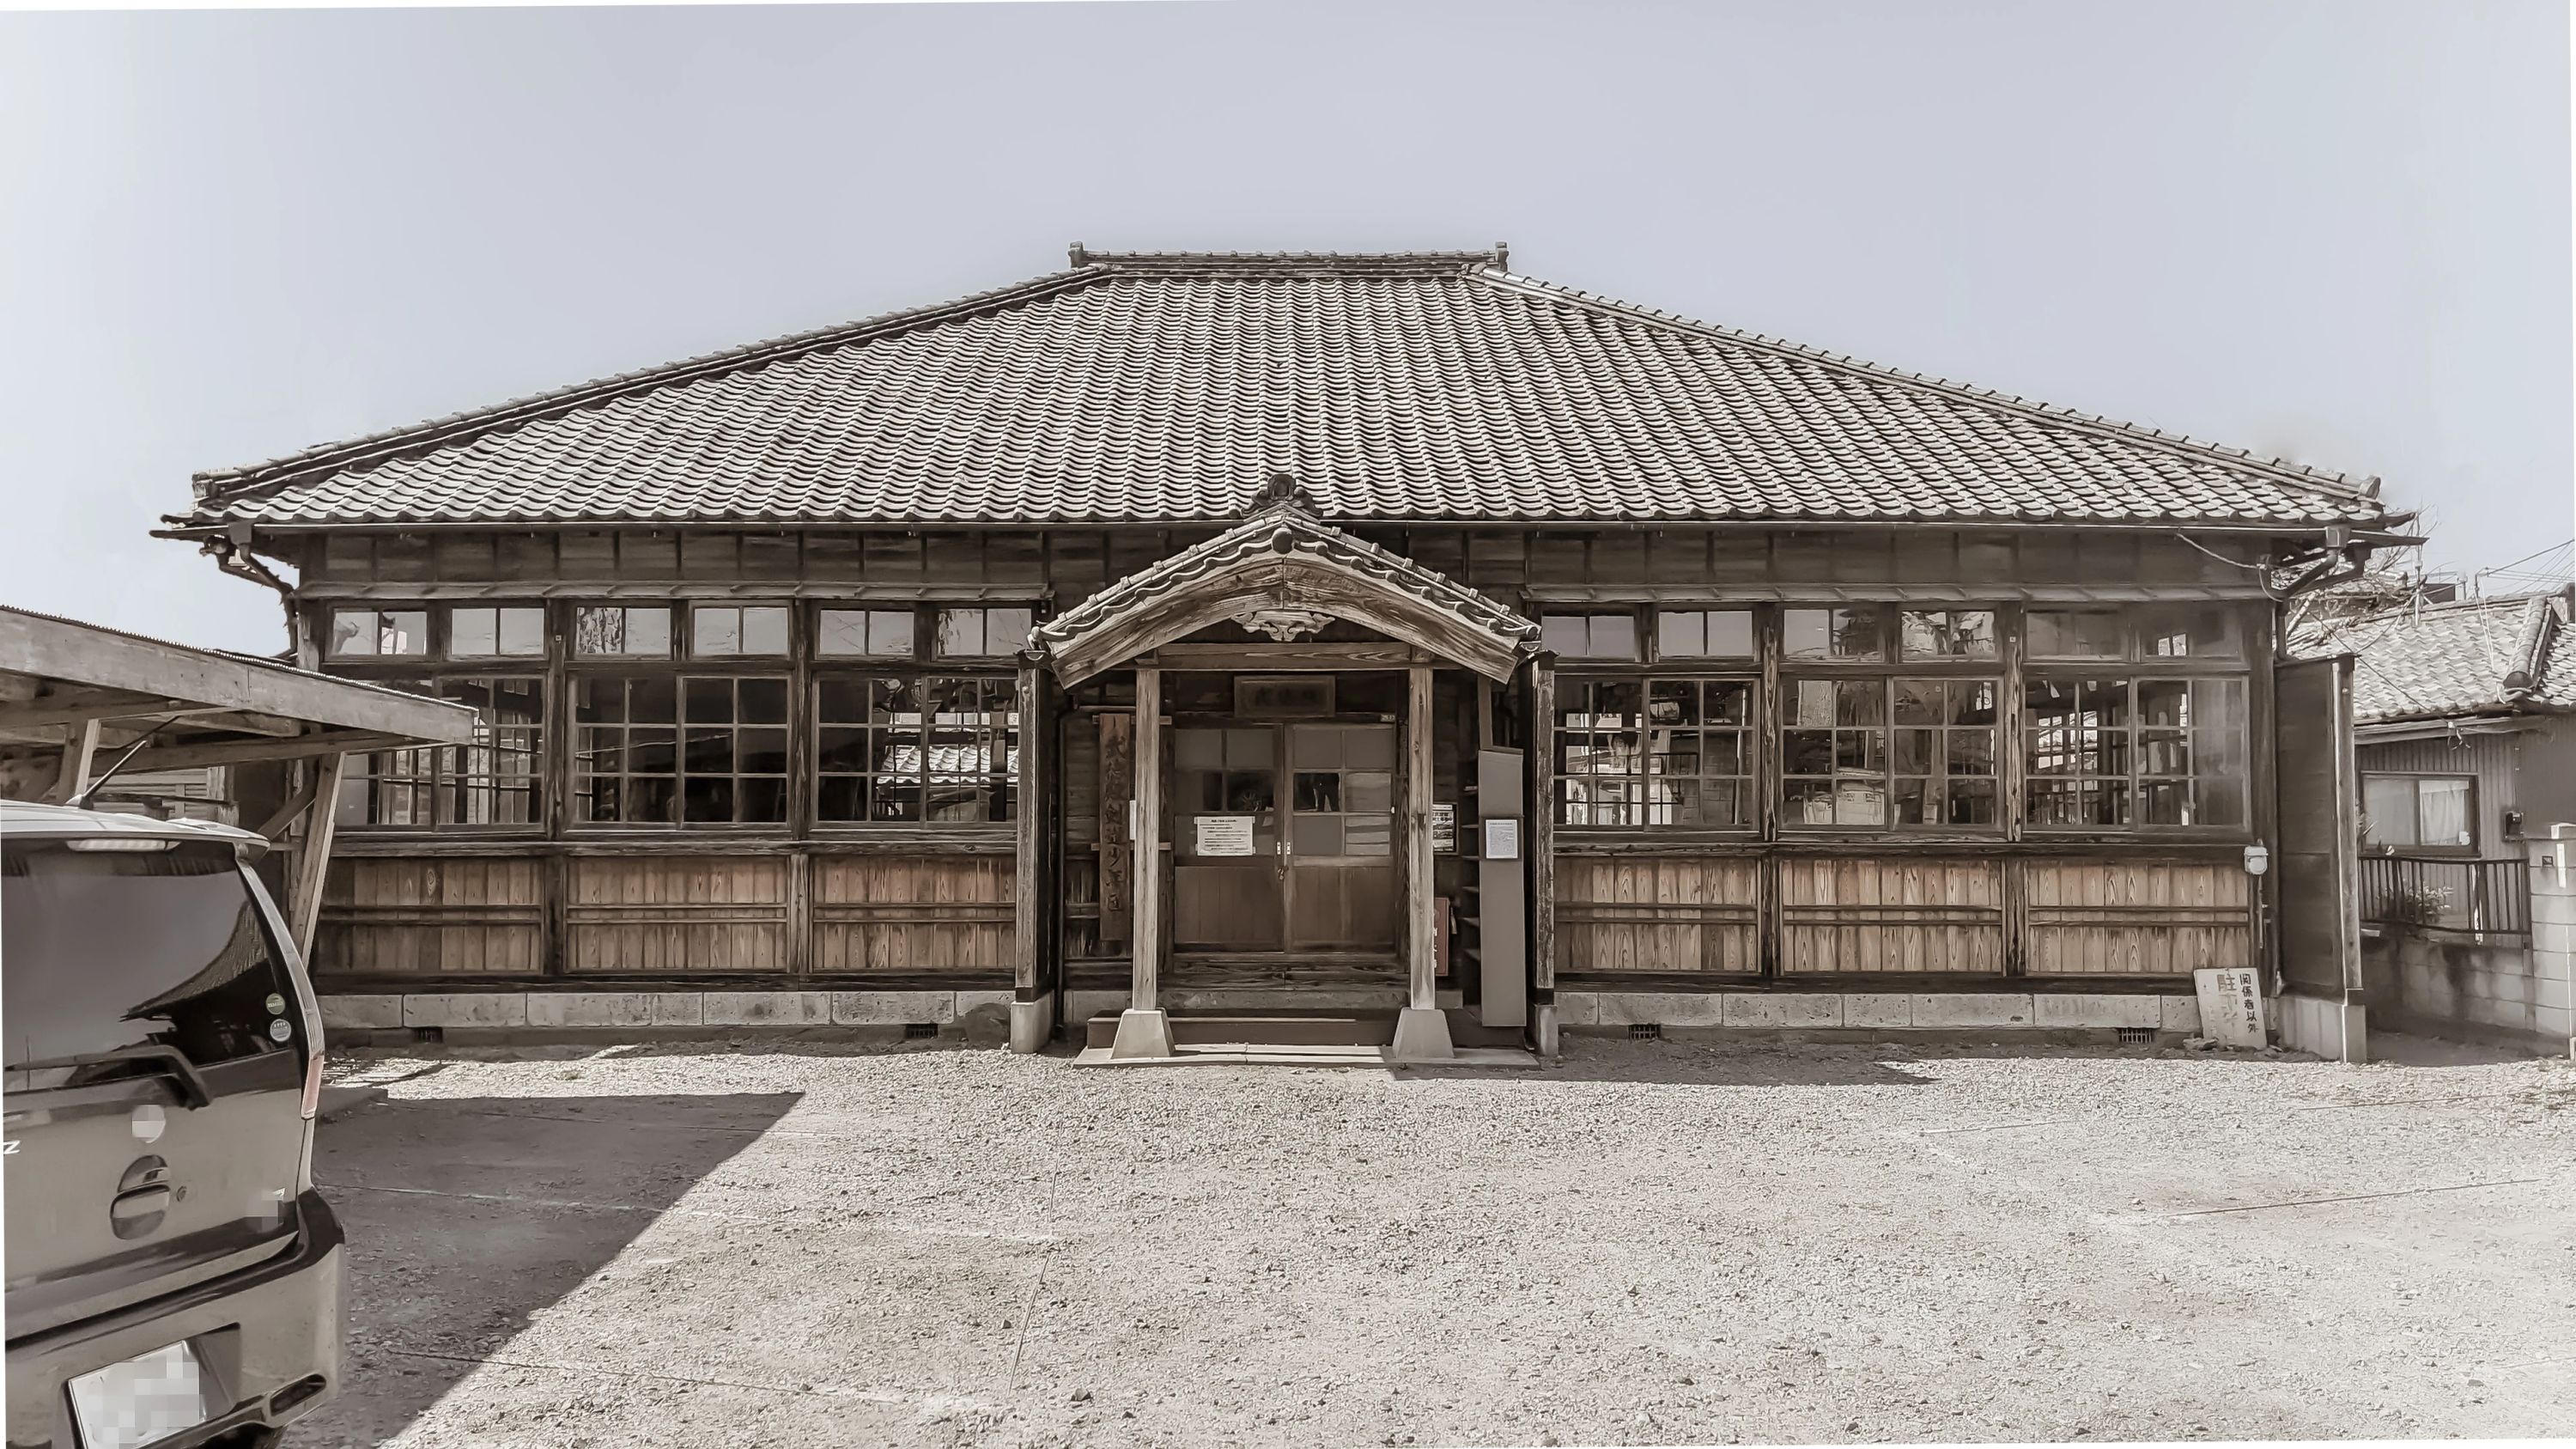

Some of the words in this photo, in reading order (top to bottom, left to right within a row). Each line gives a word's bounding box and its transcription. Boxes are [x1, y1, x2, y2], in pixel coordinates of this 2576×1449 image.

[2239, 973, 2260, 1033] 関係者以外
